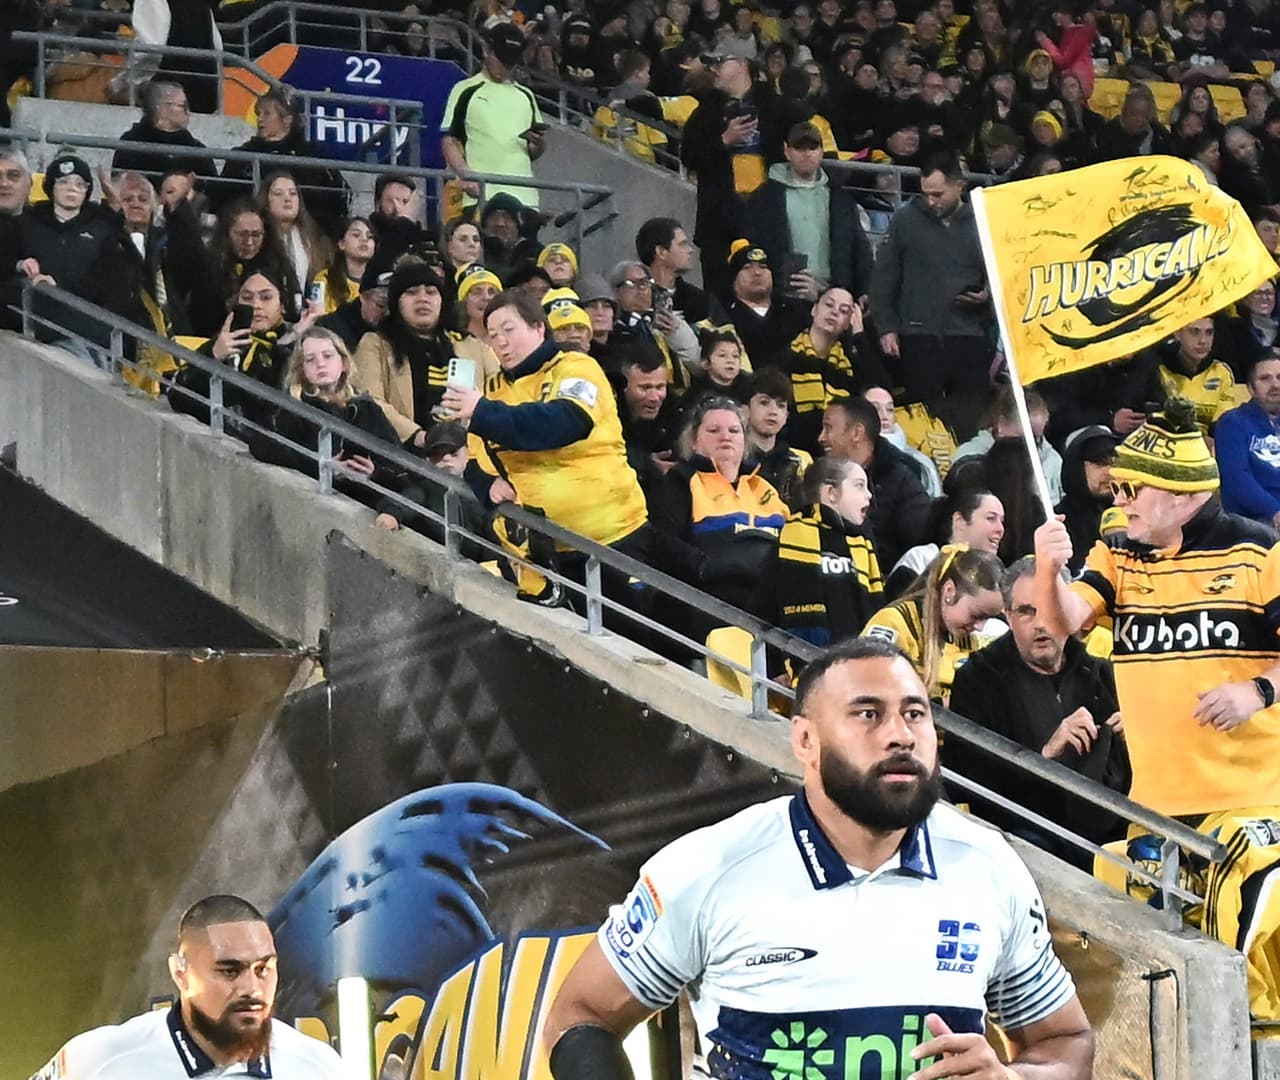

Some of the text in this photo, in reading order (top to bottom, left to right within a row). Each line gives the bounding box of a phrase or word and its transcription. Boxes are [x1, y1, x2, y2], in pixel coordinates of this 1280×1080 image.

[345, 56, 382, 85] 22
[1023, 218, 1237, 324] HURRICAN
[1114, 611, 1240, 651] Kubota
[745, 950, 797, 967] CLASSIC
[936, 960, 976, 974] BLUES
